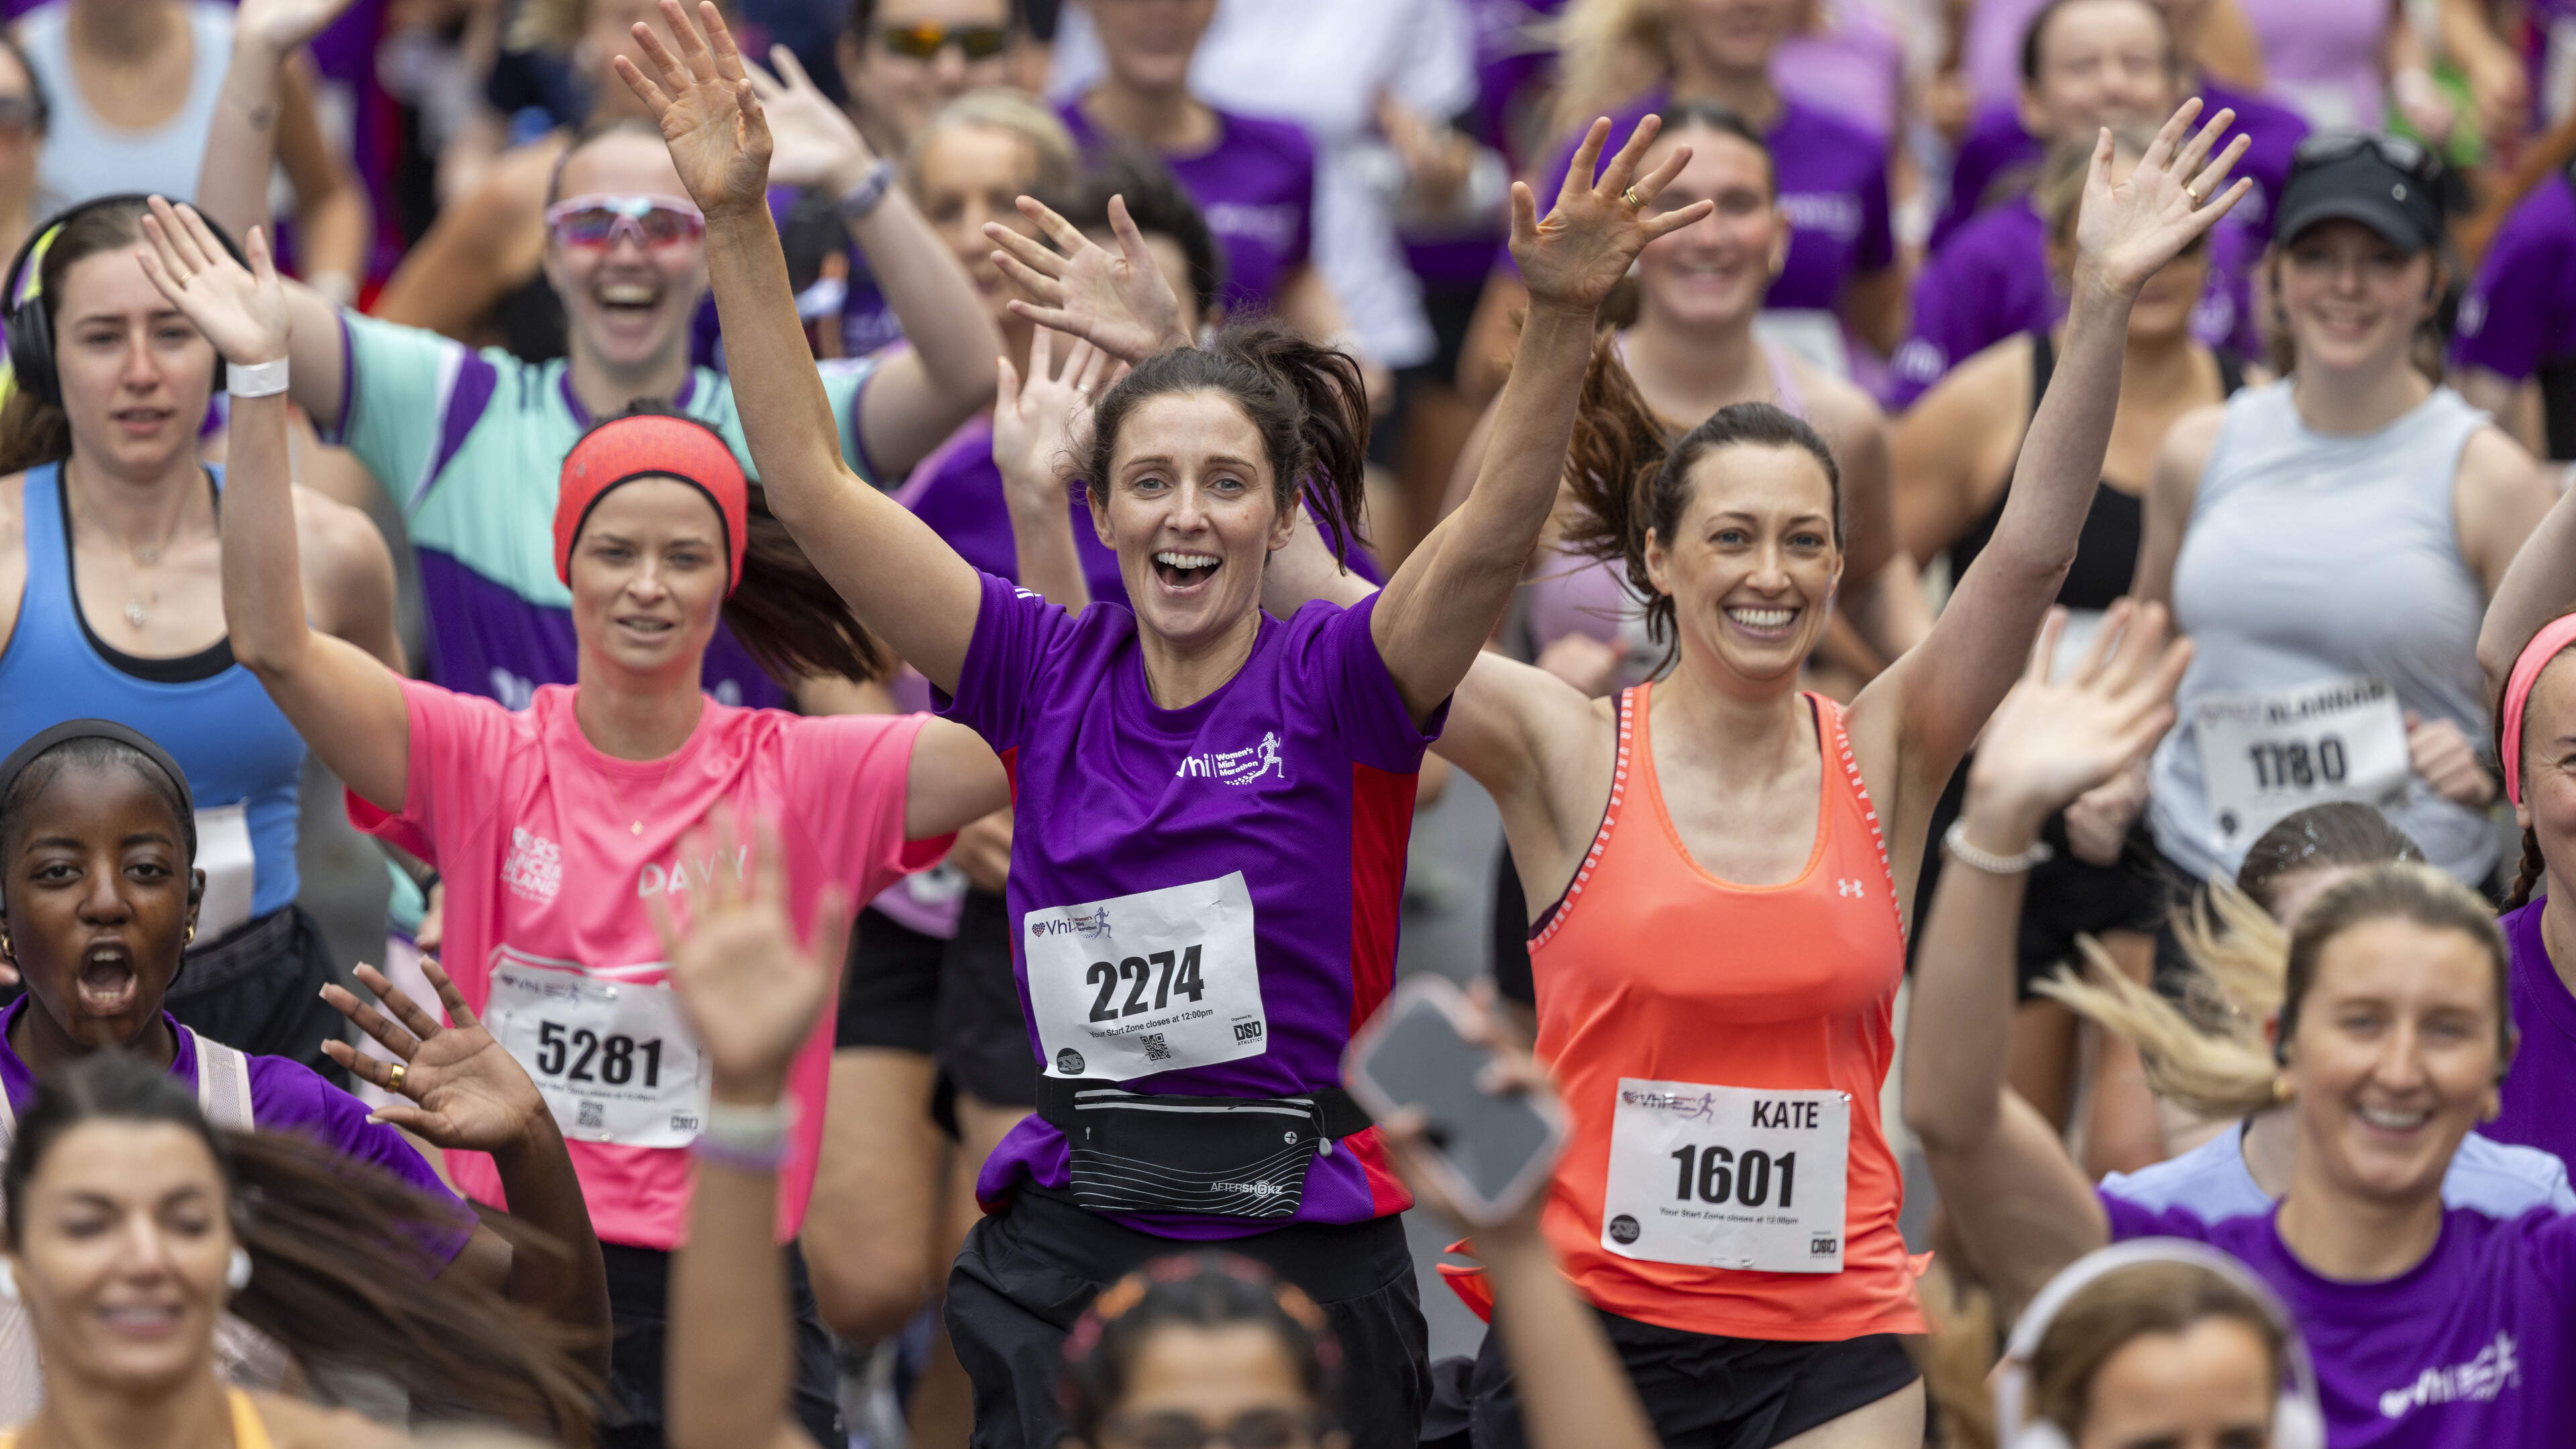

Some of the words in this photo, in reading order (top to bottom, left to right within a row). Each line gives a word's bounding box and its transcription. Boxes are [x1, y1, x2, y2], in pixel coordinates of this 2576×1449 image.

[1216, 747, 1254, 762] Women's
[1218, 759, 1236, 769] Mini
[1219, 761, 1258, 777] Marathon
[1611, 747, 1630, 807] UNDER
[1572, 815, 1615, 894] ARMOUR
[1045, 918, 1072, 936] Vhi
[1085, 944, 1205, 1024] 2274
[1089, 1030, 1106, 1038] Your
[1106, 1026, 1124, 1036] Start
[1126, 1022, 1144, 1033] Zone
[1146, 1018, 1171, 1028] closes
[1172, 1015, 1180, 1024] at
[1181, 1008, 1214, 1021] 12:00pm
[1233, 1020, 1262, 1041] DSD
[1238, 1036, 1263, 1045] ATHLETICS
[537, 1020, 663, 1088] 5281
[1752, 1100, 1820, 1129] KATE
[1670, 1144, 1797, 1208] 1601
[1210, 1181, 1283, 1197] AFTERSHOKZ
[1659, 1207, 1678, 1217] Your
[1680, 1209, 1701, 1219] Start
[1703, 1210, 1725, 1221] Zone
